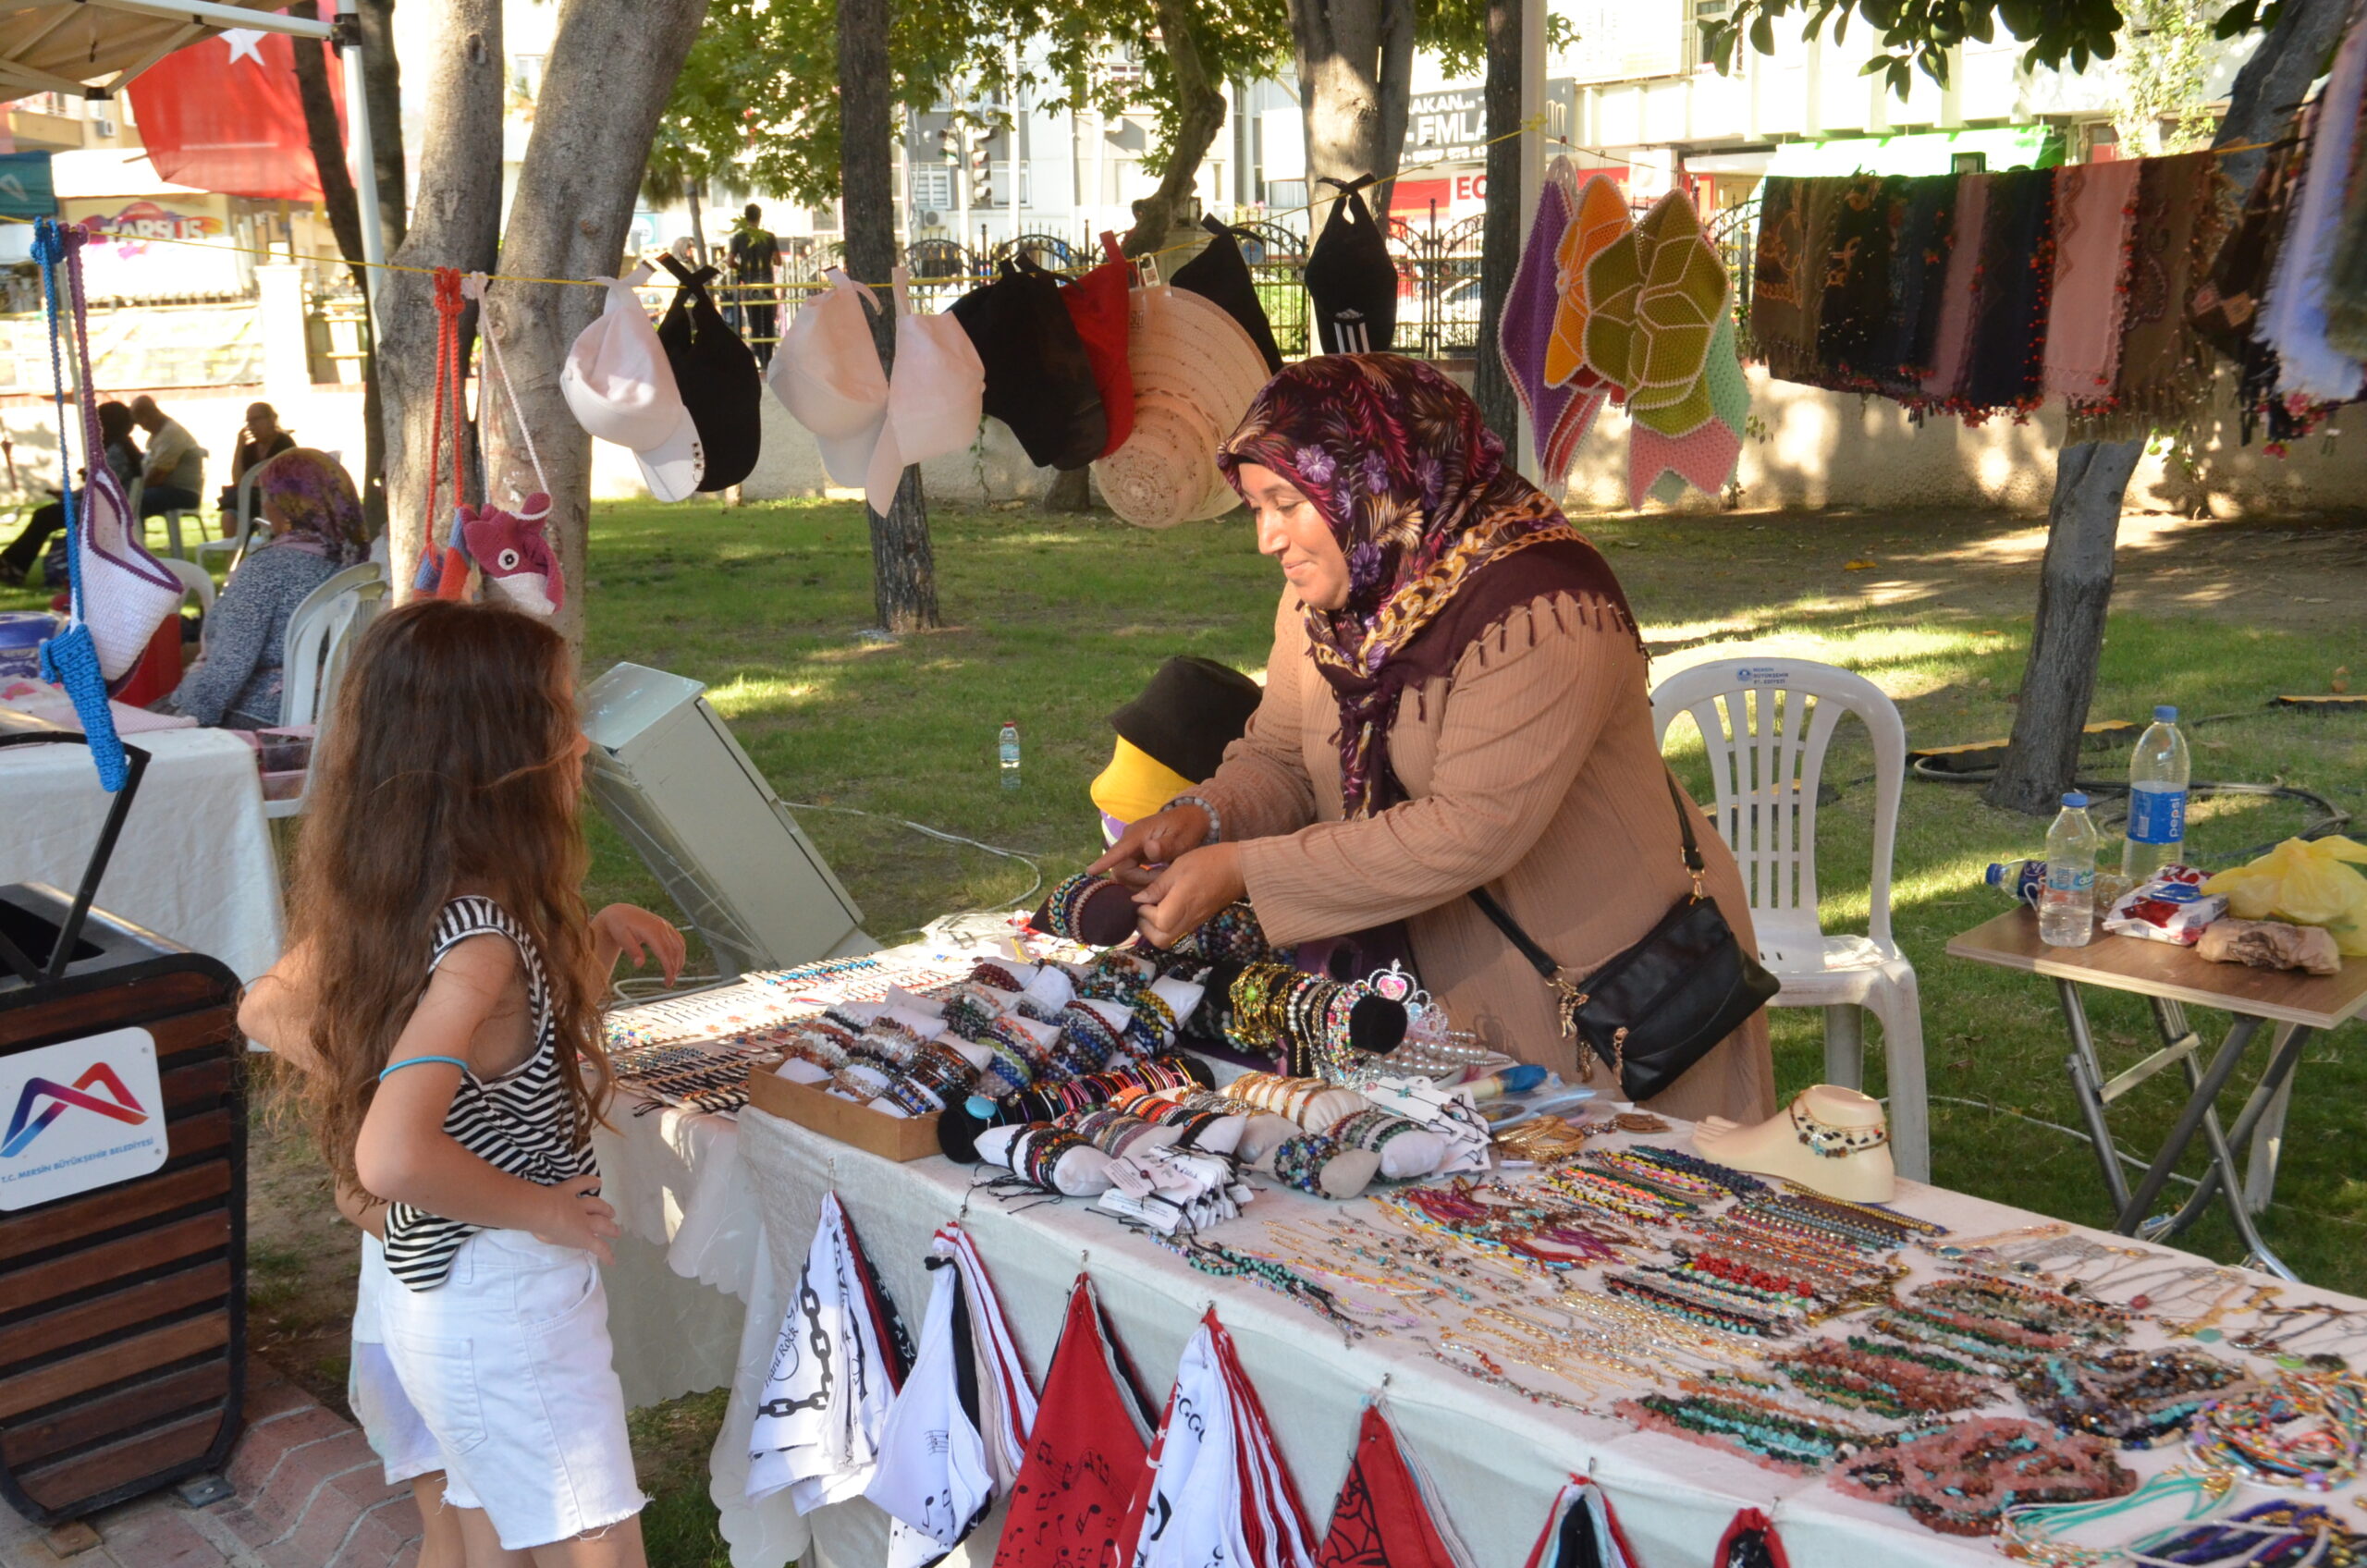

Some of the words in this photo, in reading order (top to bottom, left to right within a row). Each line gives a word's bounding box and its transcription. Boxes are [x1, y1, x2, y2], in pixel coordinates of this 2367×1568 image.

[2168, 798, 2181, 838] pepsi
[1, 1174, 17, 1183] T.C.
[18, 1165, 52, 1179] MERSİN
[54, 1150, 107, 1170] BÜYÜKŞEHİR
[110, 1137, 153, 1155] BELEDİYESİ
[779, 1325, 798, 1357] Rock
